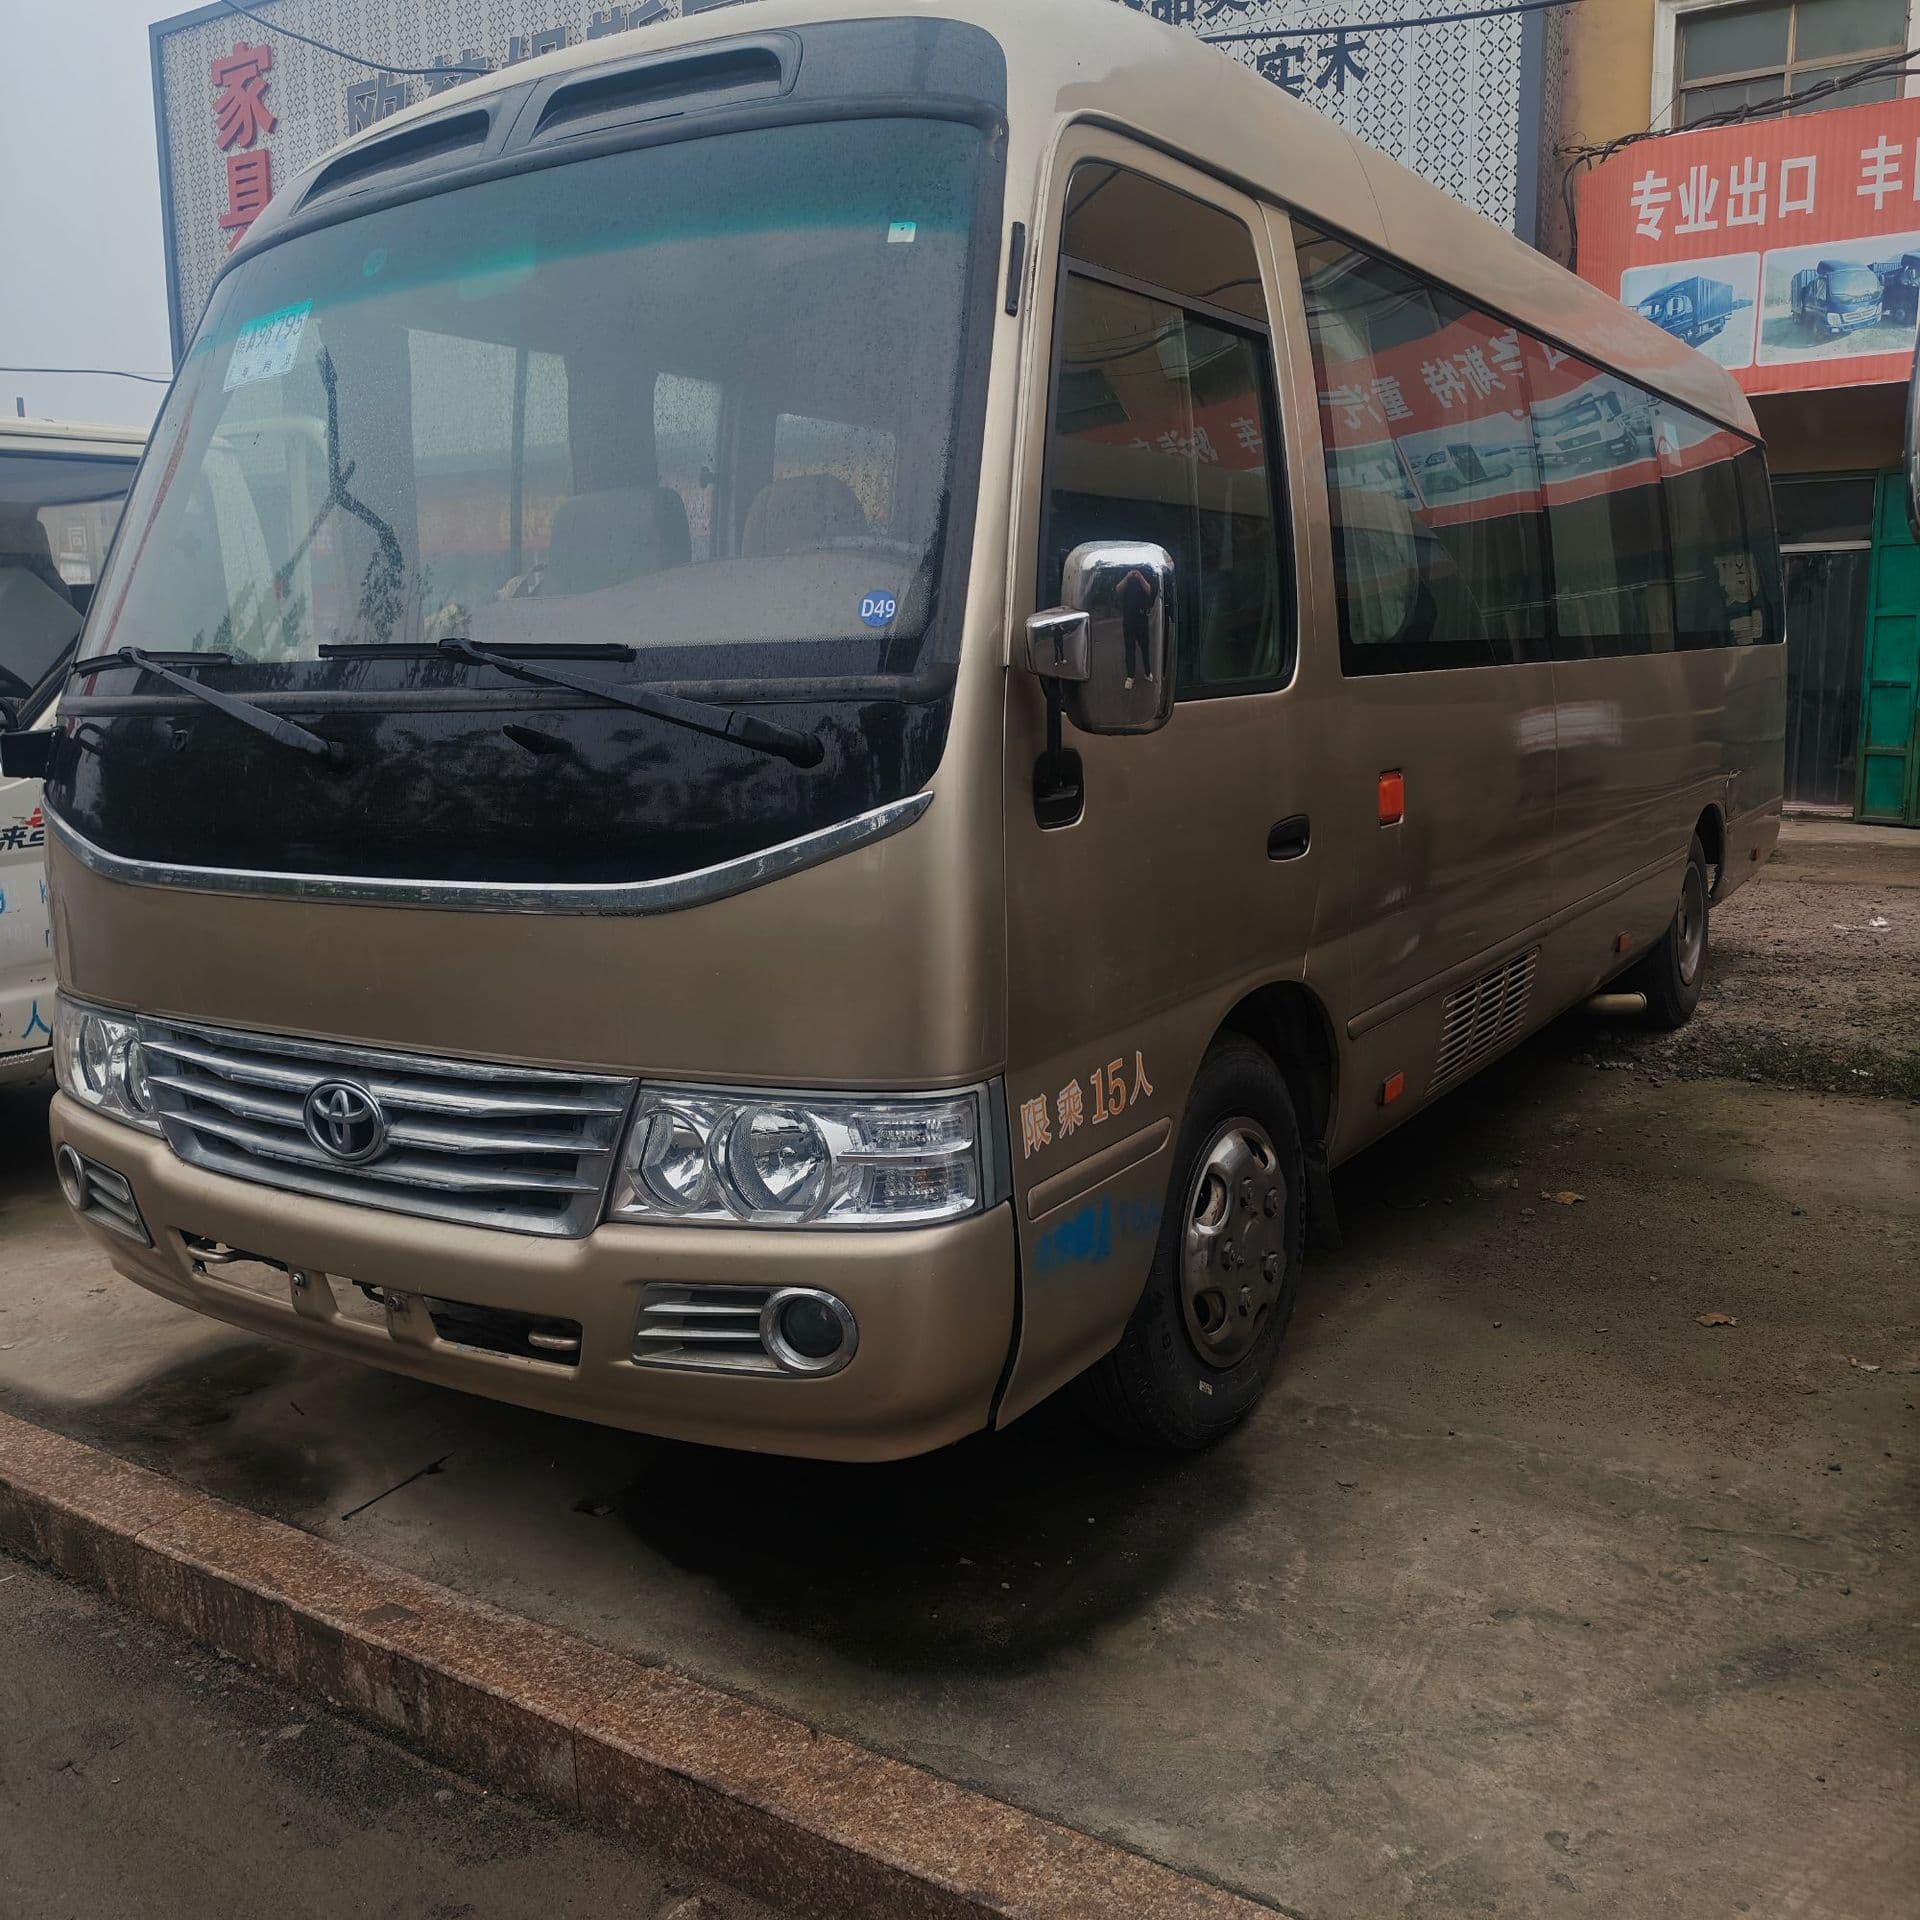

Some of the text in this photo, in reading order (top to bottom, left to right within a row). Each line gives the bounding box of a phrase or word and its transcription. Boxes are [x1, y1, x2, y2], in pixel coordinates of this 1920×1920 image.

[1257, 31, 1366, 99] 实木
[211, 41, 277, 251] 家具
[1631, 135, 1920, 240] 专业出口 丰
[861, 599, 896, 618] D49
[1020, 1050, 1153, 1159] 限乘15人
